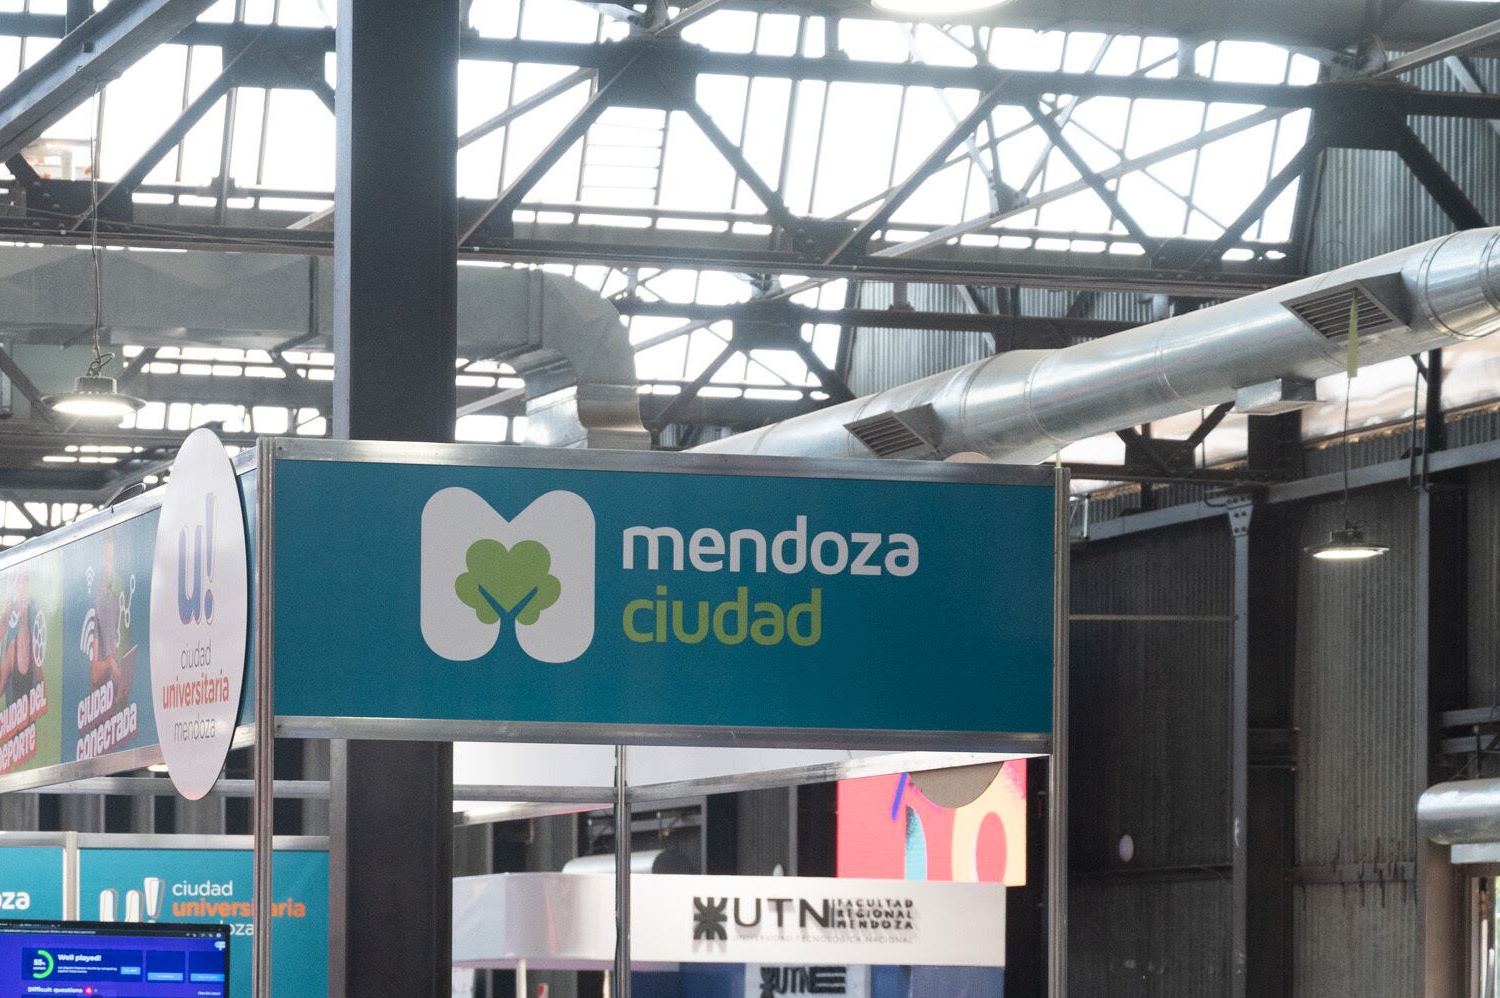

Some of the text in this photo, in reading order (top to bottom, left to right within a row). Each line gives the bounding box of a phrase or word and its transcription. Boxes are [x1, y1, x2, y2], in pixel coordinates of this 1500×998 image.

[622, 514, 920, 577] mendoza
[622, 584, 823, 647] ciudad
[180, 639, 212, 670] ciudad
[162, 669, 230, 710] universitaria
[173, 712, 216, 743] mendoza
[172, 880, 233, 897] ciudad
[733, 896, 830, 928] UTN
[837, 898, 914, 909] FACULTAD
[837, 909, 913, 919] REGIONAL
[837, 920, 914, 930] MENDOZA
[57, 953, 102, 963] Well played!
[53, 986, 83, 995] questions
